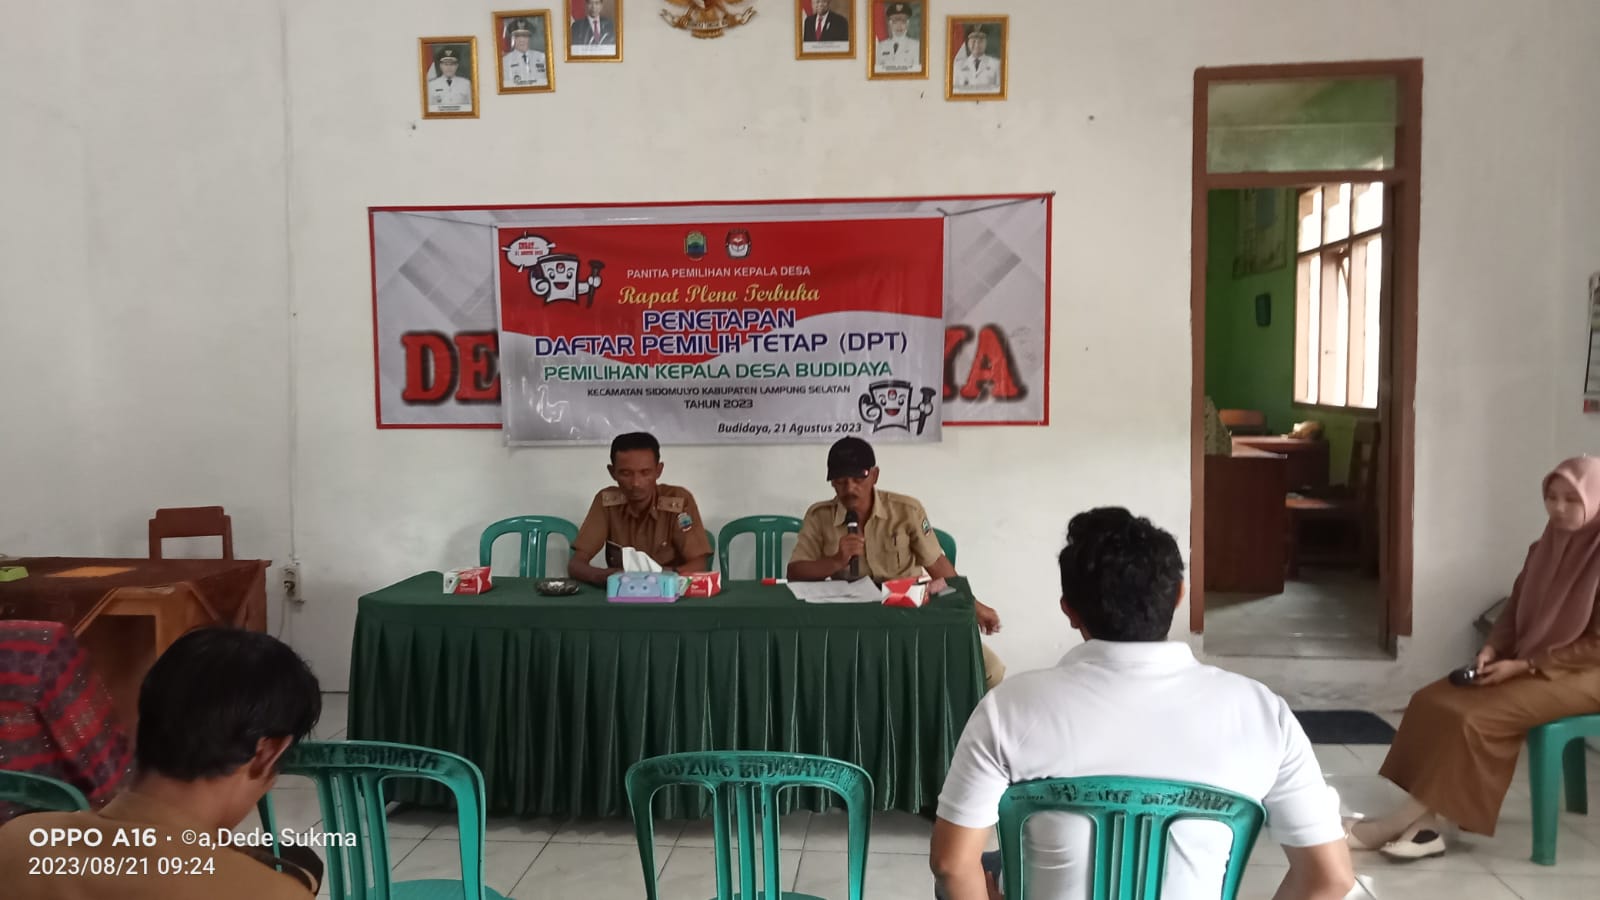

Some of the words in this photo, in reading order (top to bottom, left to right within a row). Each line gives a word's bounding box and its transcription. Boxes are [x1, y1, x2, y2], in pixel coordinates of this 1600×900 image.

[627, 268, 669, 279] PANITIA
[672, 268, 731, 278] PEMILIHAN
[734, 267, 777, 277] KEPALA
[781, 266, 811, 276] DESA
[618, 285, 679, 308] Rapat
[685, 283, 738, 303] Pleno
[743, 282, 821, 303] Terbuka
[642, 308, 796, 332] PENETAPAN
[535, 335, 635, 358] DAFTAR
[641, 333, 741, 356] PEMILIH
[748, 332, 828, 353] TETAP
[839, 331, 908, 354] (DPT)
[544, 364, 649, 381] PEMILIHAN
[655, 362, 730, 380] KEPALA
[736, 362, 790, 378] DESA
[796, 361, 893, 378] BUDIDAYA
[587, 387, 643, 397] KECAMATAN
[645, 387, 699, 396] SIDOMULYO
[701, 386, 757, 395] KABUPATEN
[759, 385, 806, 395] LAMPUNG
[808, 385, 851, 394] SELATAN
[684, 400, 721, 409] TAHUN
[723, 399, 753, 409] 2023
[718, 422, 771, 436] Budidaya,
[774, 423, 786, 432] 21
[789, 422, 832, 435] Agustus
[835, 422, 862, 432] 2023
